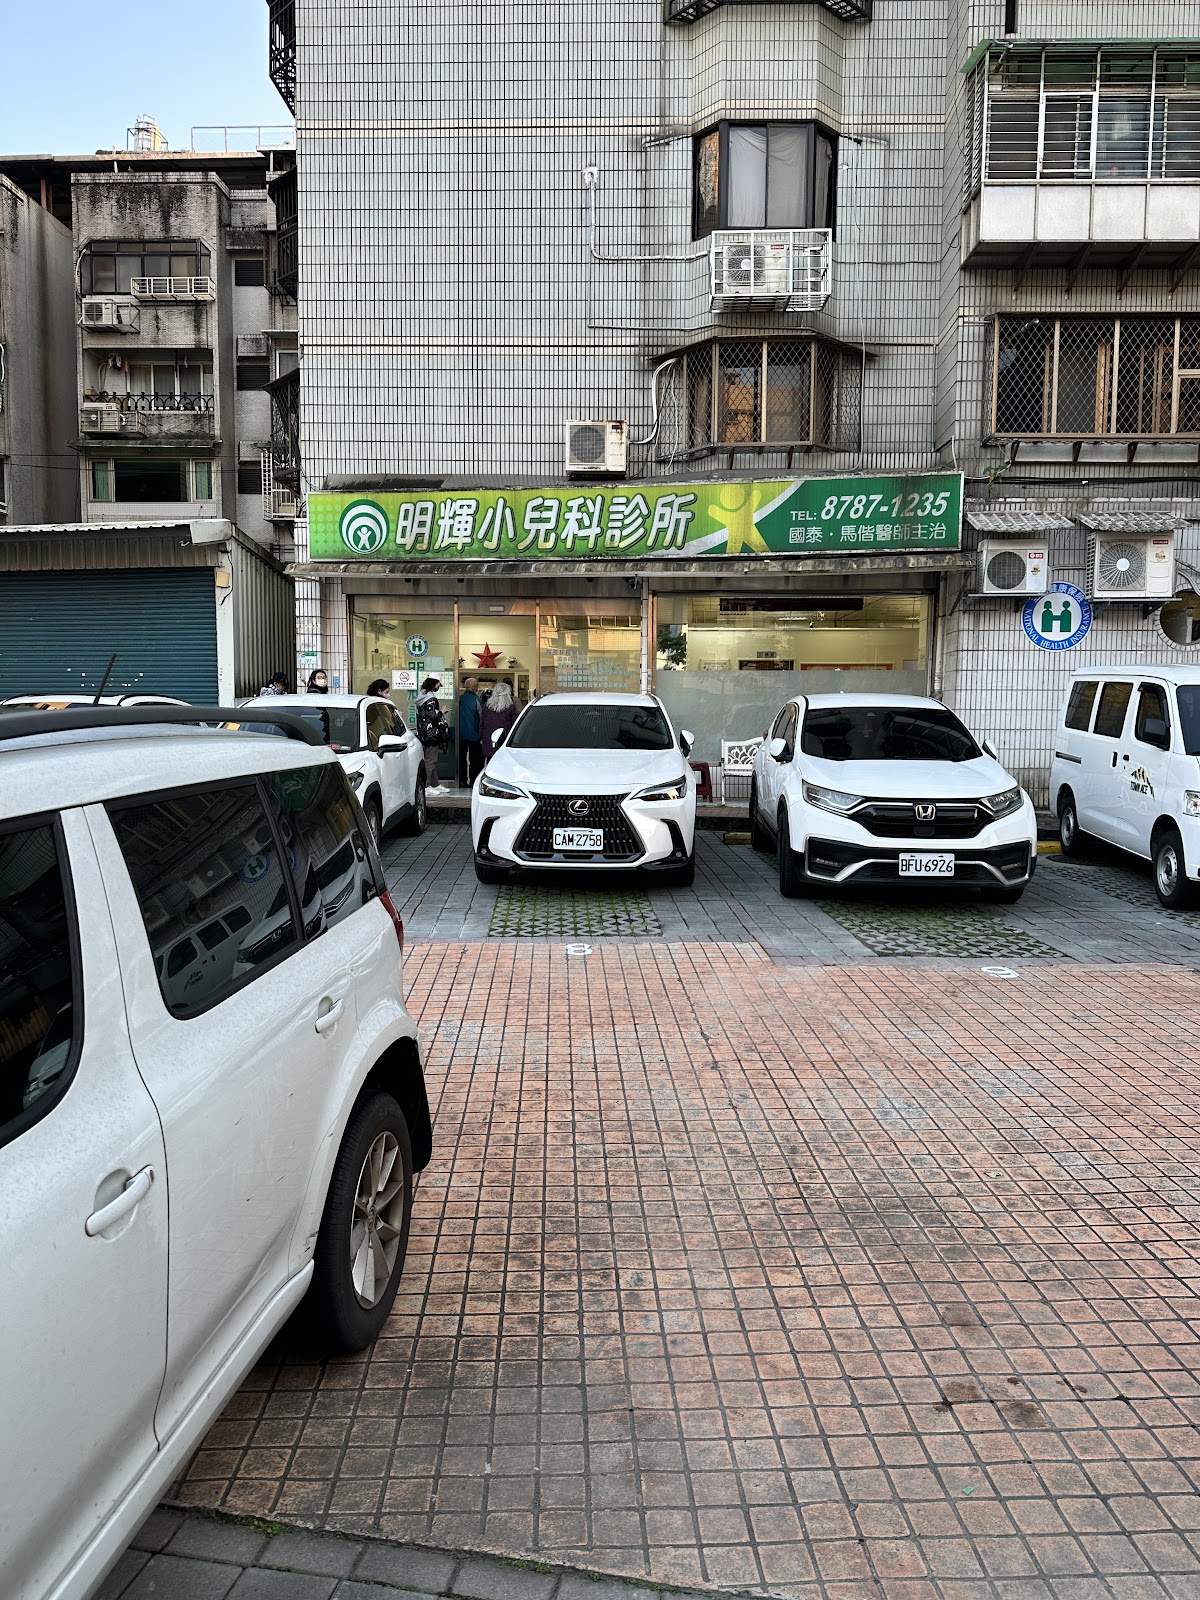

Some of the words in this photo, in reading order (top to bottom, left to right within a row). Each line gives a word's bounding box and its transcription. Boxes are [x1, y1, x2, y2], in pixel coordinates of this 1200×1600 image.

[395, 493, 698, 552] 明輝小兒科診所
[790, 510, 817, 521] TEL:
[820, 491, 951, 521] 8787-1235
[1023, 607, 1040, 643] NATIONAL
[1039, 639, 1070, 650] HEALTH
[1069, 604, 1091, 645] INSURANCE
[900, 857, 954, 874] BFU-6926
